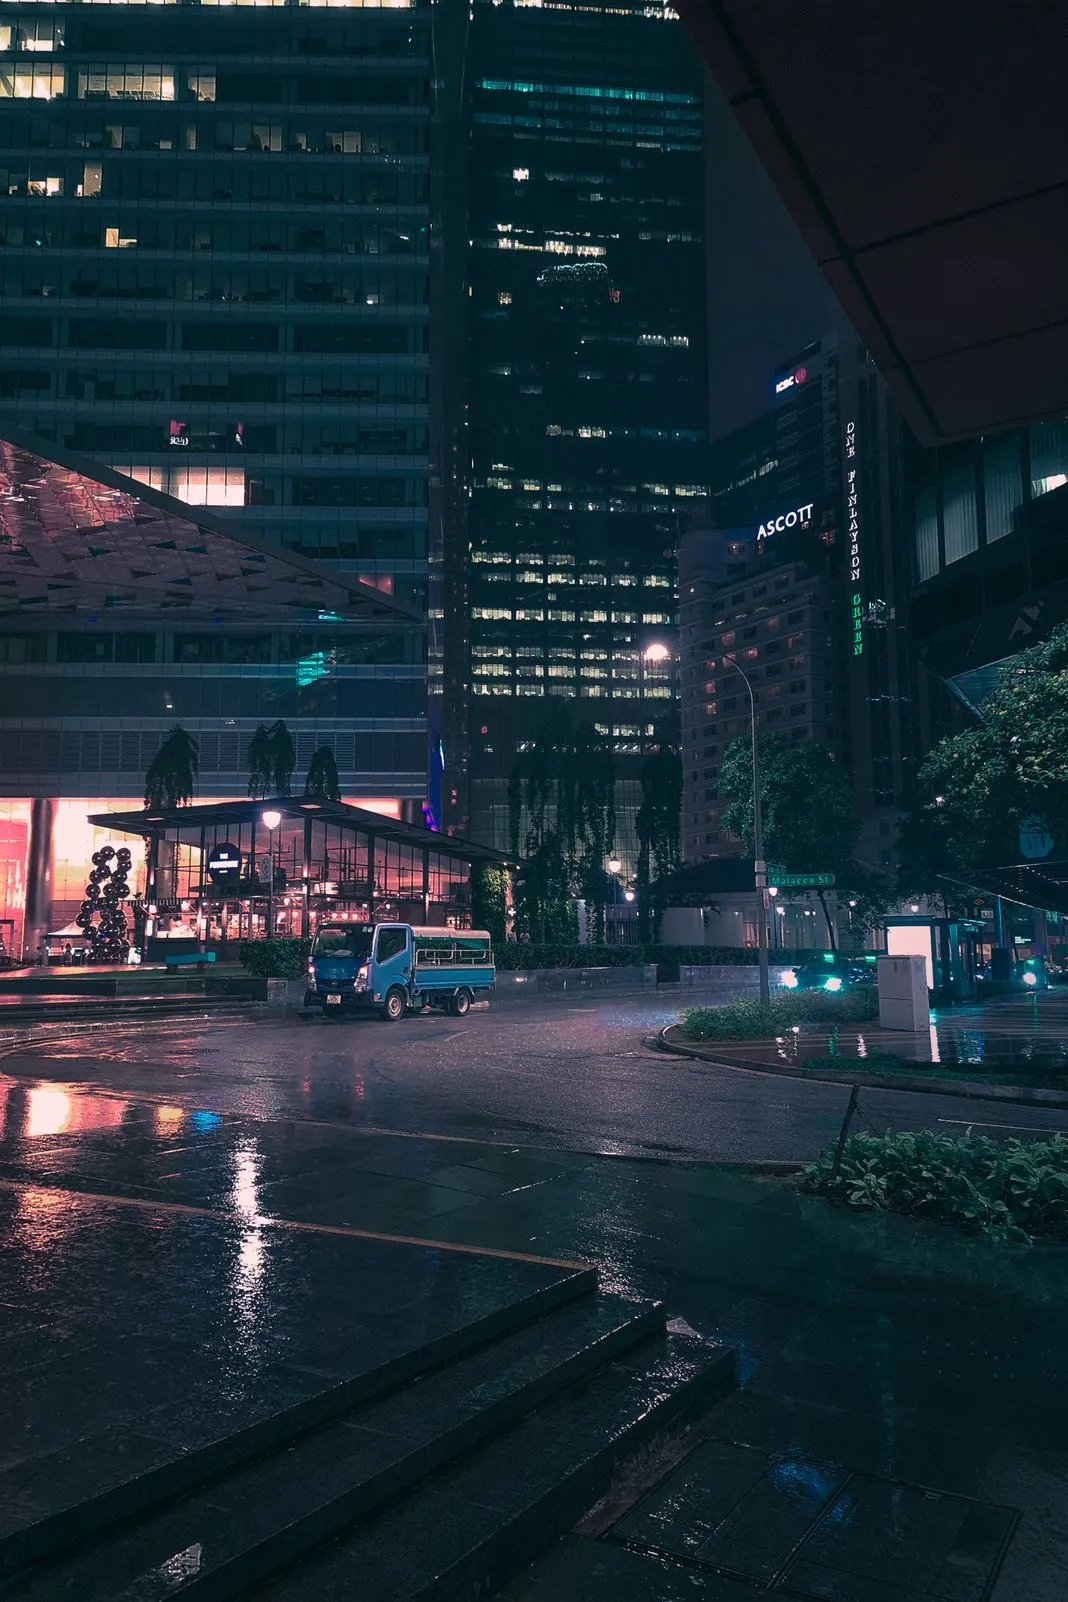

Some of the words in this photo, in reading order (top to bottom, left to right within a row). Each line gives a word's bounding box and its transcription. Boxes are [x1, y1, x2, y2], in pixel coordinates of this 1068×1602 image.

[845, 421, 856, 458] ONE
[757, 503, 814, 541] ASCOTT
[847, 469, 862, 581] FINLAYSON
[771, 876, 814, 885] Malacca
[818, 875, 830, 884] St
